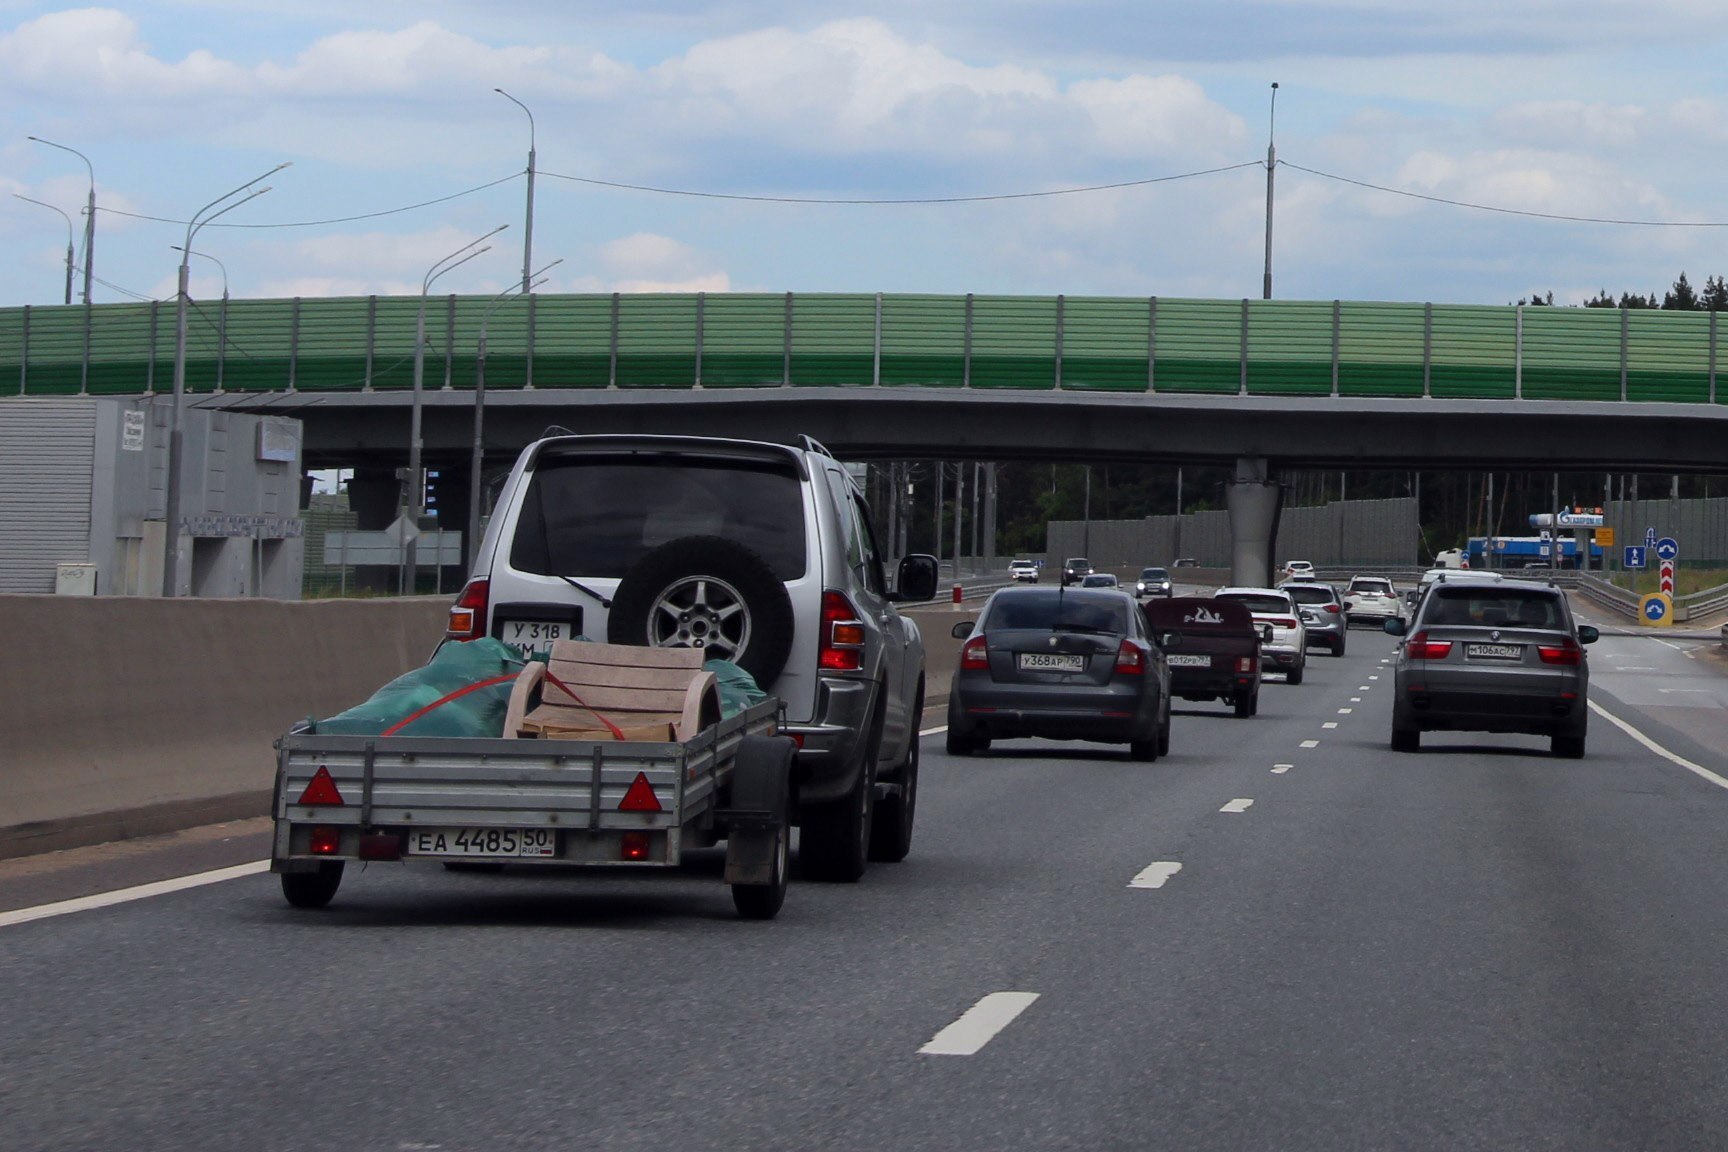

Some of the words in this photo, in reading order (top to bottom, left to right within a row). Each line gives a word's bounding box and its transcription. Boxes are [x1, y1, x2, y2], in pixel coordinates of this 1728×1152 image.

[514, 623, 524, 638] У
[530, 624, 560, 639] 318
[418, 834, 447, 851] ЕА
[455, 829, 517, 852] 4485
[524, 828, 547, 846] 50
